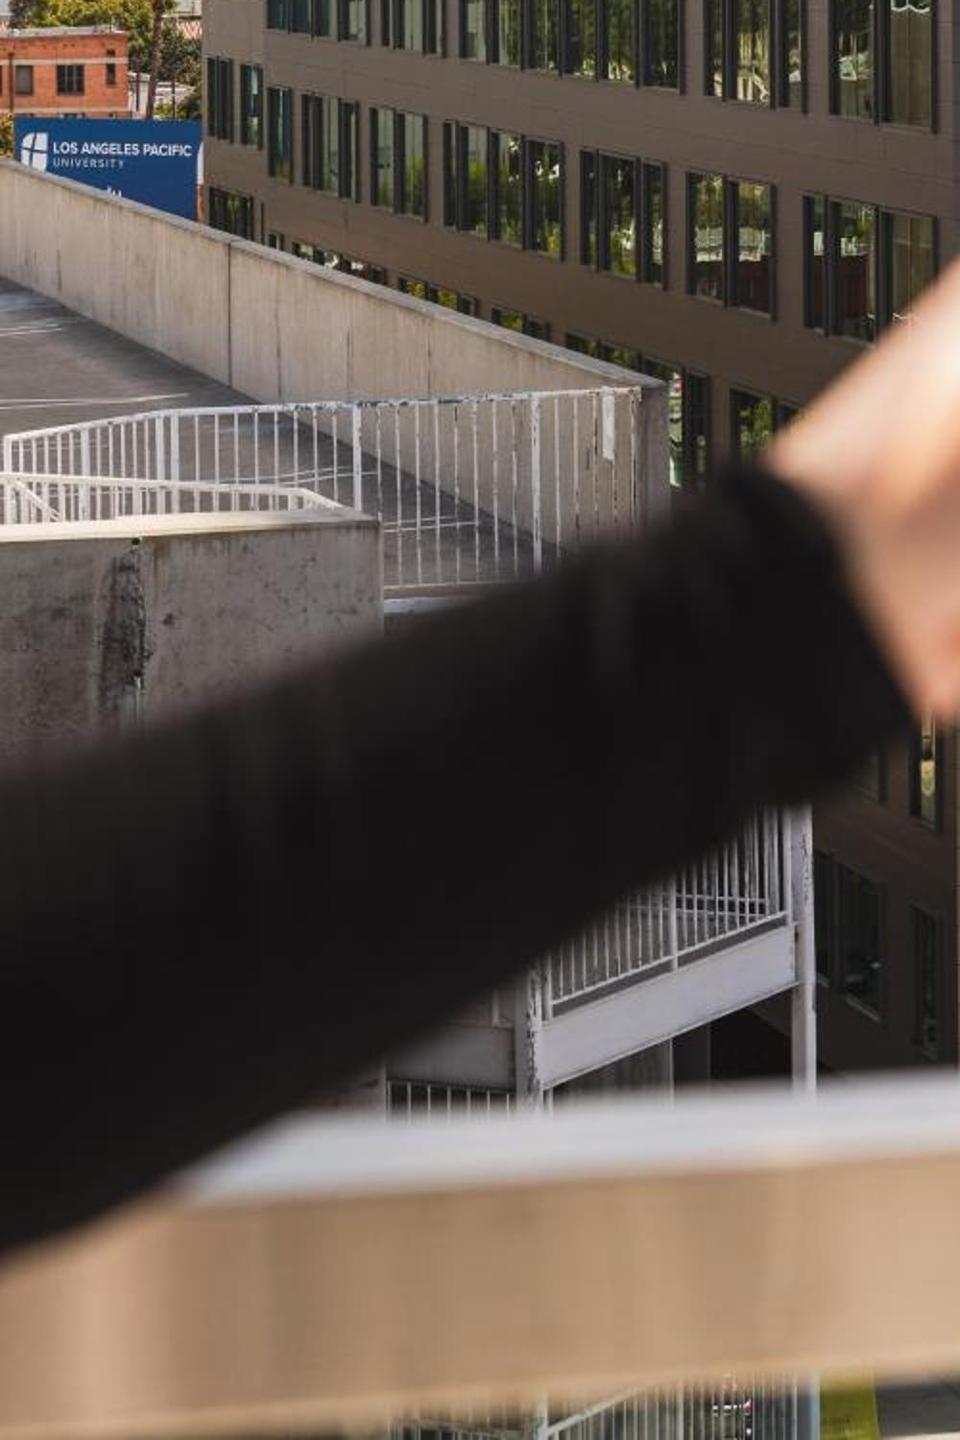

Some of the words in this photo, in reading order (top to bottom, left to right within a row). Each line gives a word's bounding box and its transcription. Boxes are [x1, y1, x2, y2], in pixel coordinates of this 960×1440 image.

[53, 141, 78, 154] LOS
[81, 142, 140, 156] ANGELES
[143, 144, 192, 157] PACIFIC
[53, 157, 124, 169] UNIVERSITY
